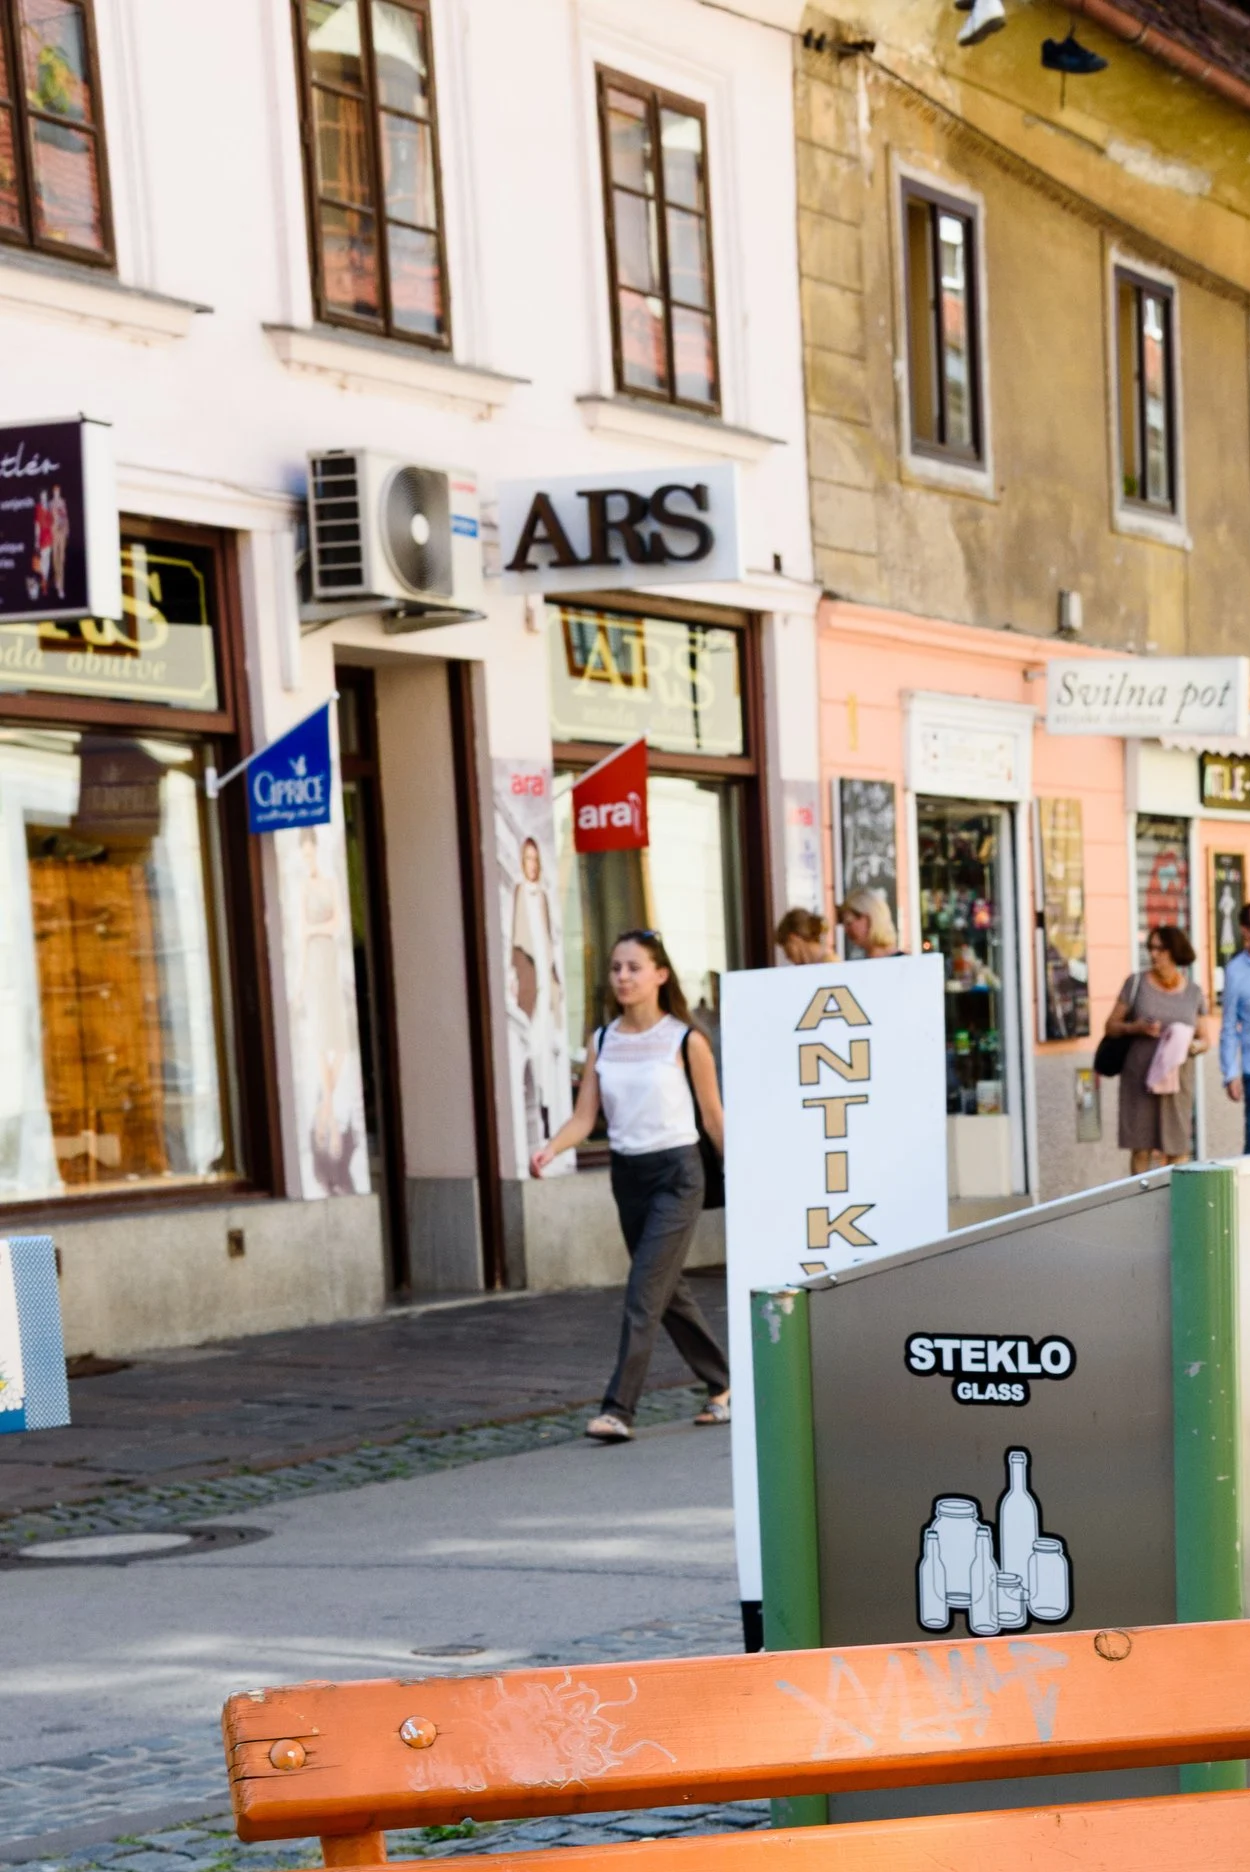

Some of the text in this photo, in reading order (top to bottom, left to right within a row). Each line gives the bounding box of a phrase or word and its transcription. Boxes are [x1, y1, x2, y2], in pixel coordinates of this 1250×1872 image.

[504, 483, 714, 571] ARS
[66, 642, 168, 682] obutve
[572, 628, 715, 711] ARS
[1056, 670, 1232, 725] Svilna pot
[511, 773, 545, 797] ara
[578, 801, 632, 830] ara
[795, 984, 878, 1276] ANTIK
[909, 1337, 1071, 1375] STEKLO
[956, 1381, 1025, 1402] GLASS
